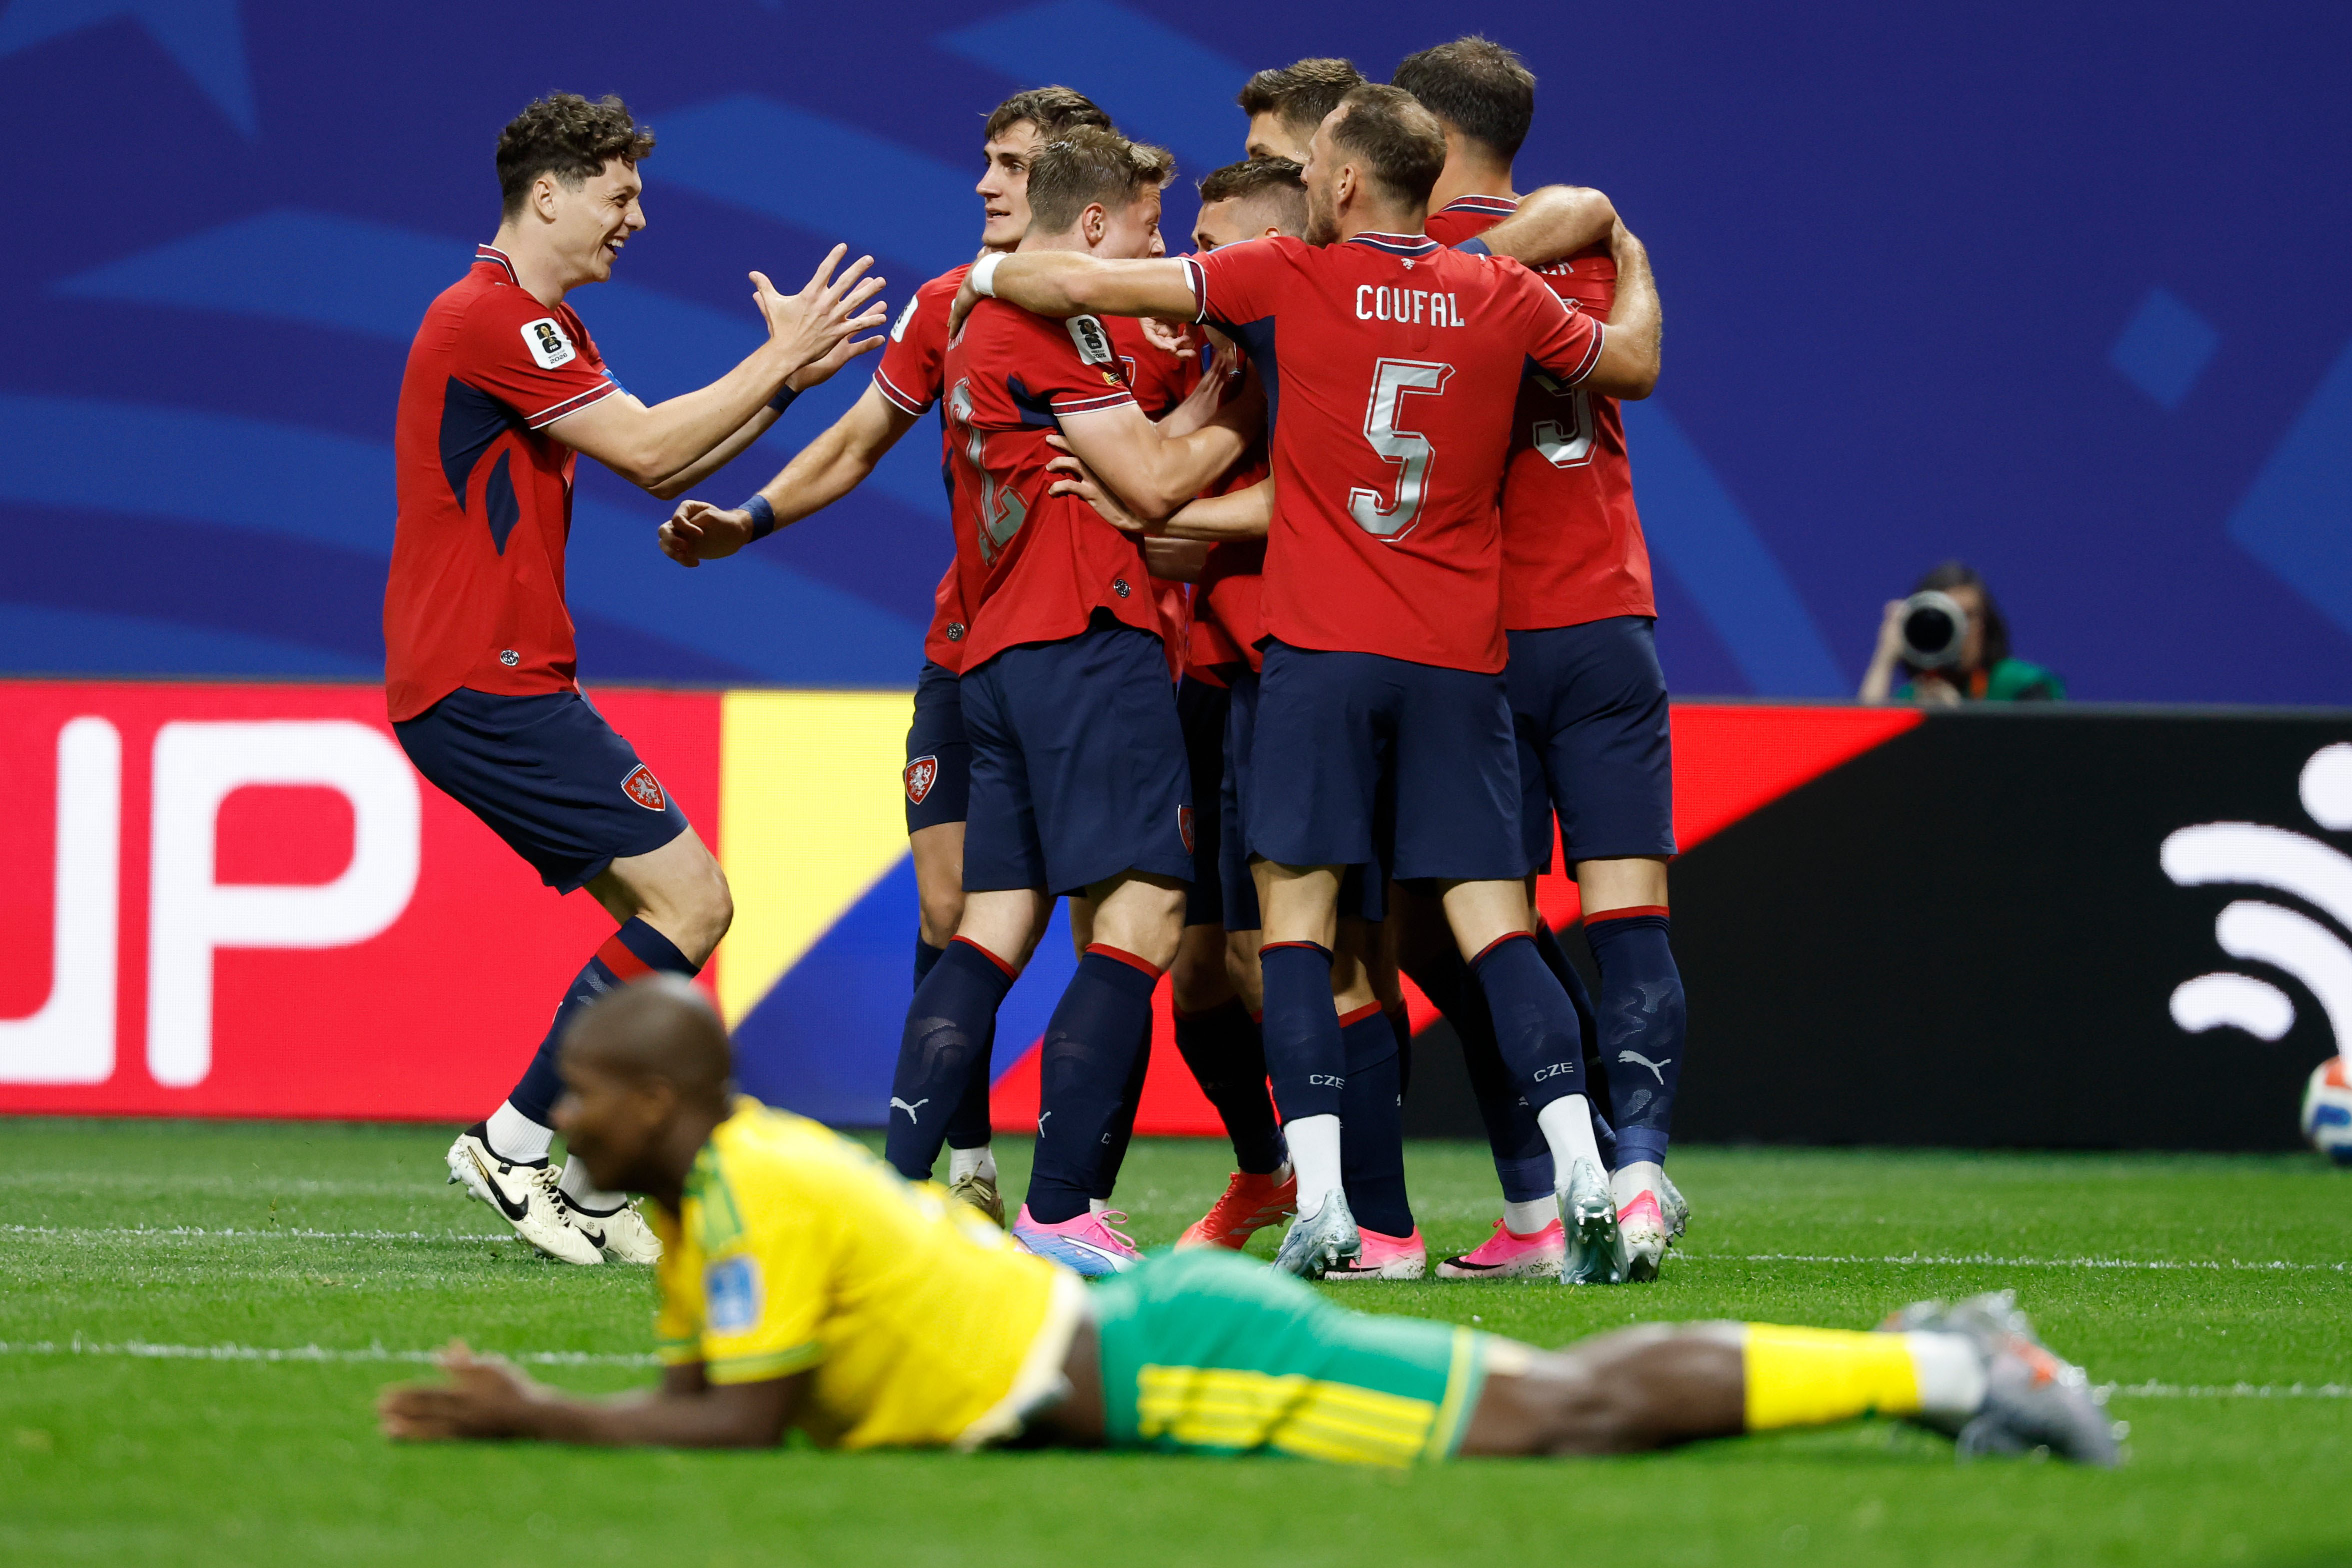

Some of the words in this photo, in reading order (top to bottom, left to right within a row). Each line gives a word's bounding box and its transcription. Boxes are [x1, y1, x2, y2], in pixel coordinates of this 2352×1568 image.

[1356, 284, 1465, 327] COUFAL
[549, 352, 568, 364] 2026
[1347, 357, 1456, 543] 5
[943, 376, 1029, 566] 2
[1309, 1074, 1345, 1090] CZE
[1533, 1062, 1574, 1082] CZE
[1336, 1195, 1348, 1222] ULTRA
